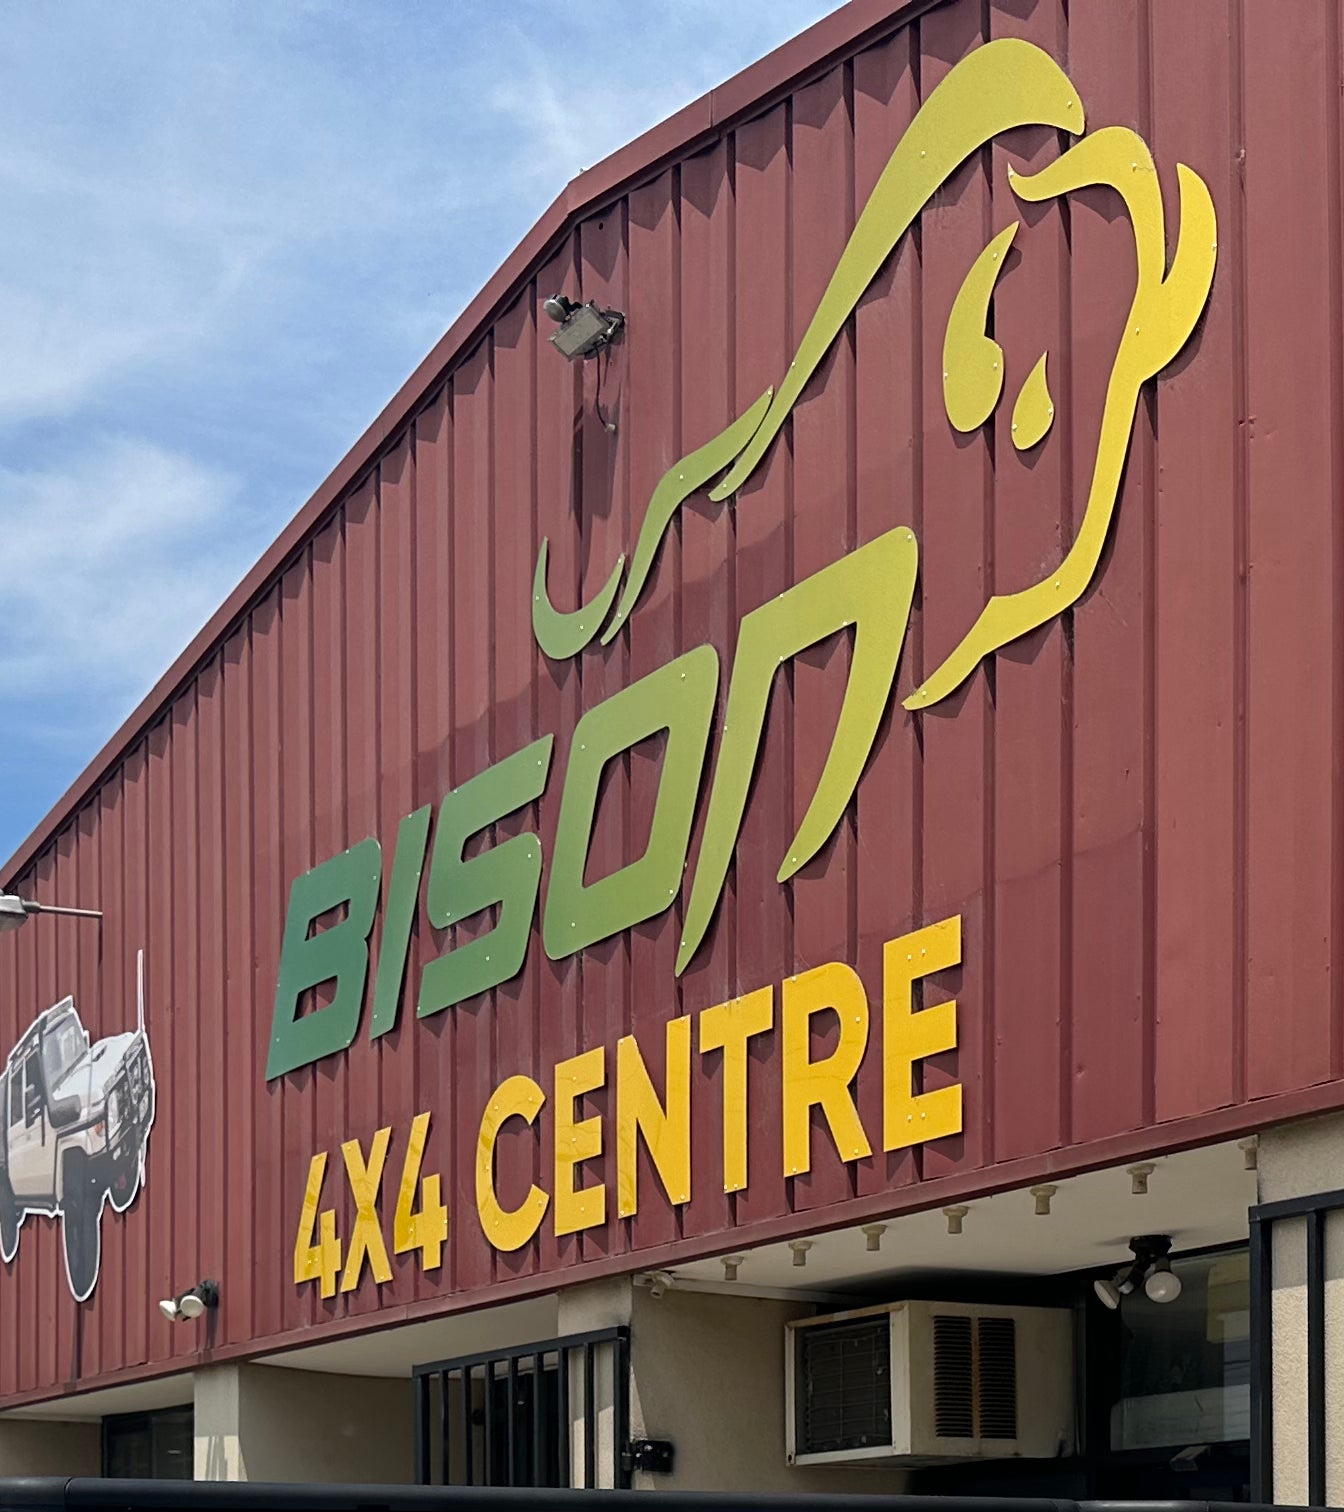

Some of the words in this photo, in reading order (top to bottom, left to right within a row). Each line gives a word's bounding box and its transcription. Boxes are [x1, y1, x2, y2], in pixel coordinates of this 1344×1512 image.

[265, 525, 919, 1081] BISON
[293, 1110, 448, 1300] 4X4
[476, 914, 962, 1252] CENTRE
